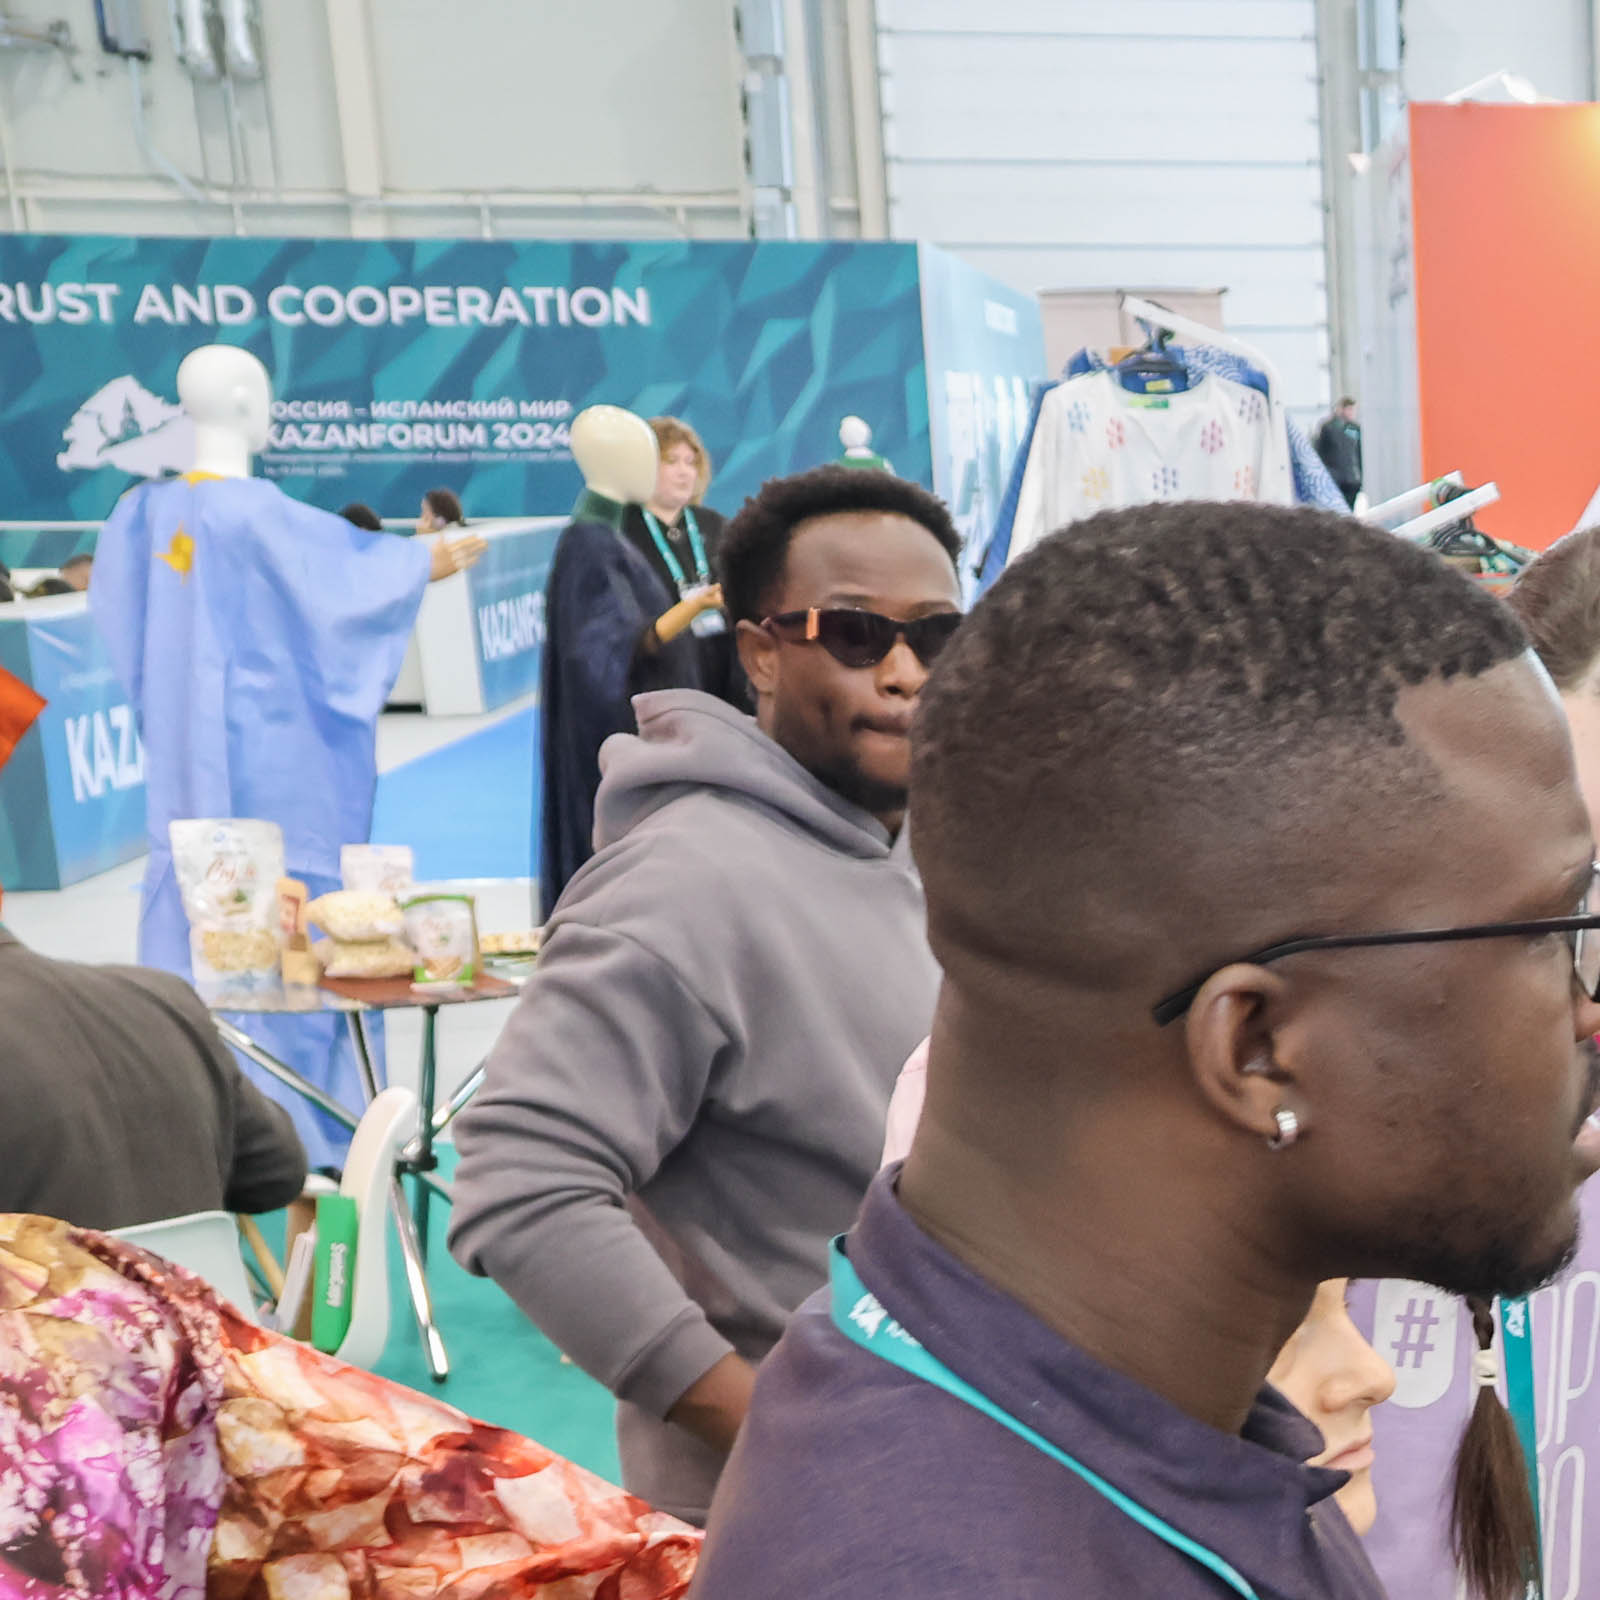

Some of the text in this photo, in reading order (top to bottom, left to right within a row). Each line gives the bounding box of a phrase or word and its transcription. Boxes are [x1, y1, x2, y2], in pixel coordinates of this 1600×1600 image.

[133, 284, 257, 326] AND
[267, 285, 652, 328] COOPERATION
[267, 400, 349, 420] ОССИЯ
[370, 397, 516, 420] ИСЛАМСКИЙ
[520, 400, 572, 420] МИР
[493, 422, 573, 449] 2024
[64, 704, 145, 804] KAZ
